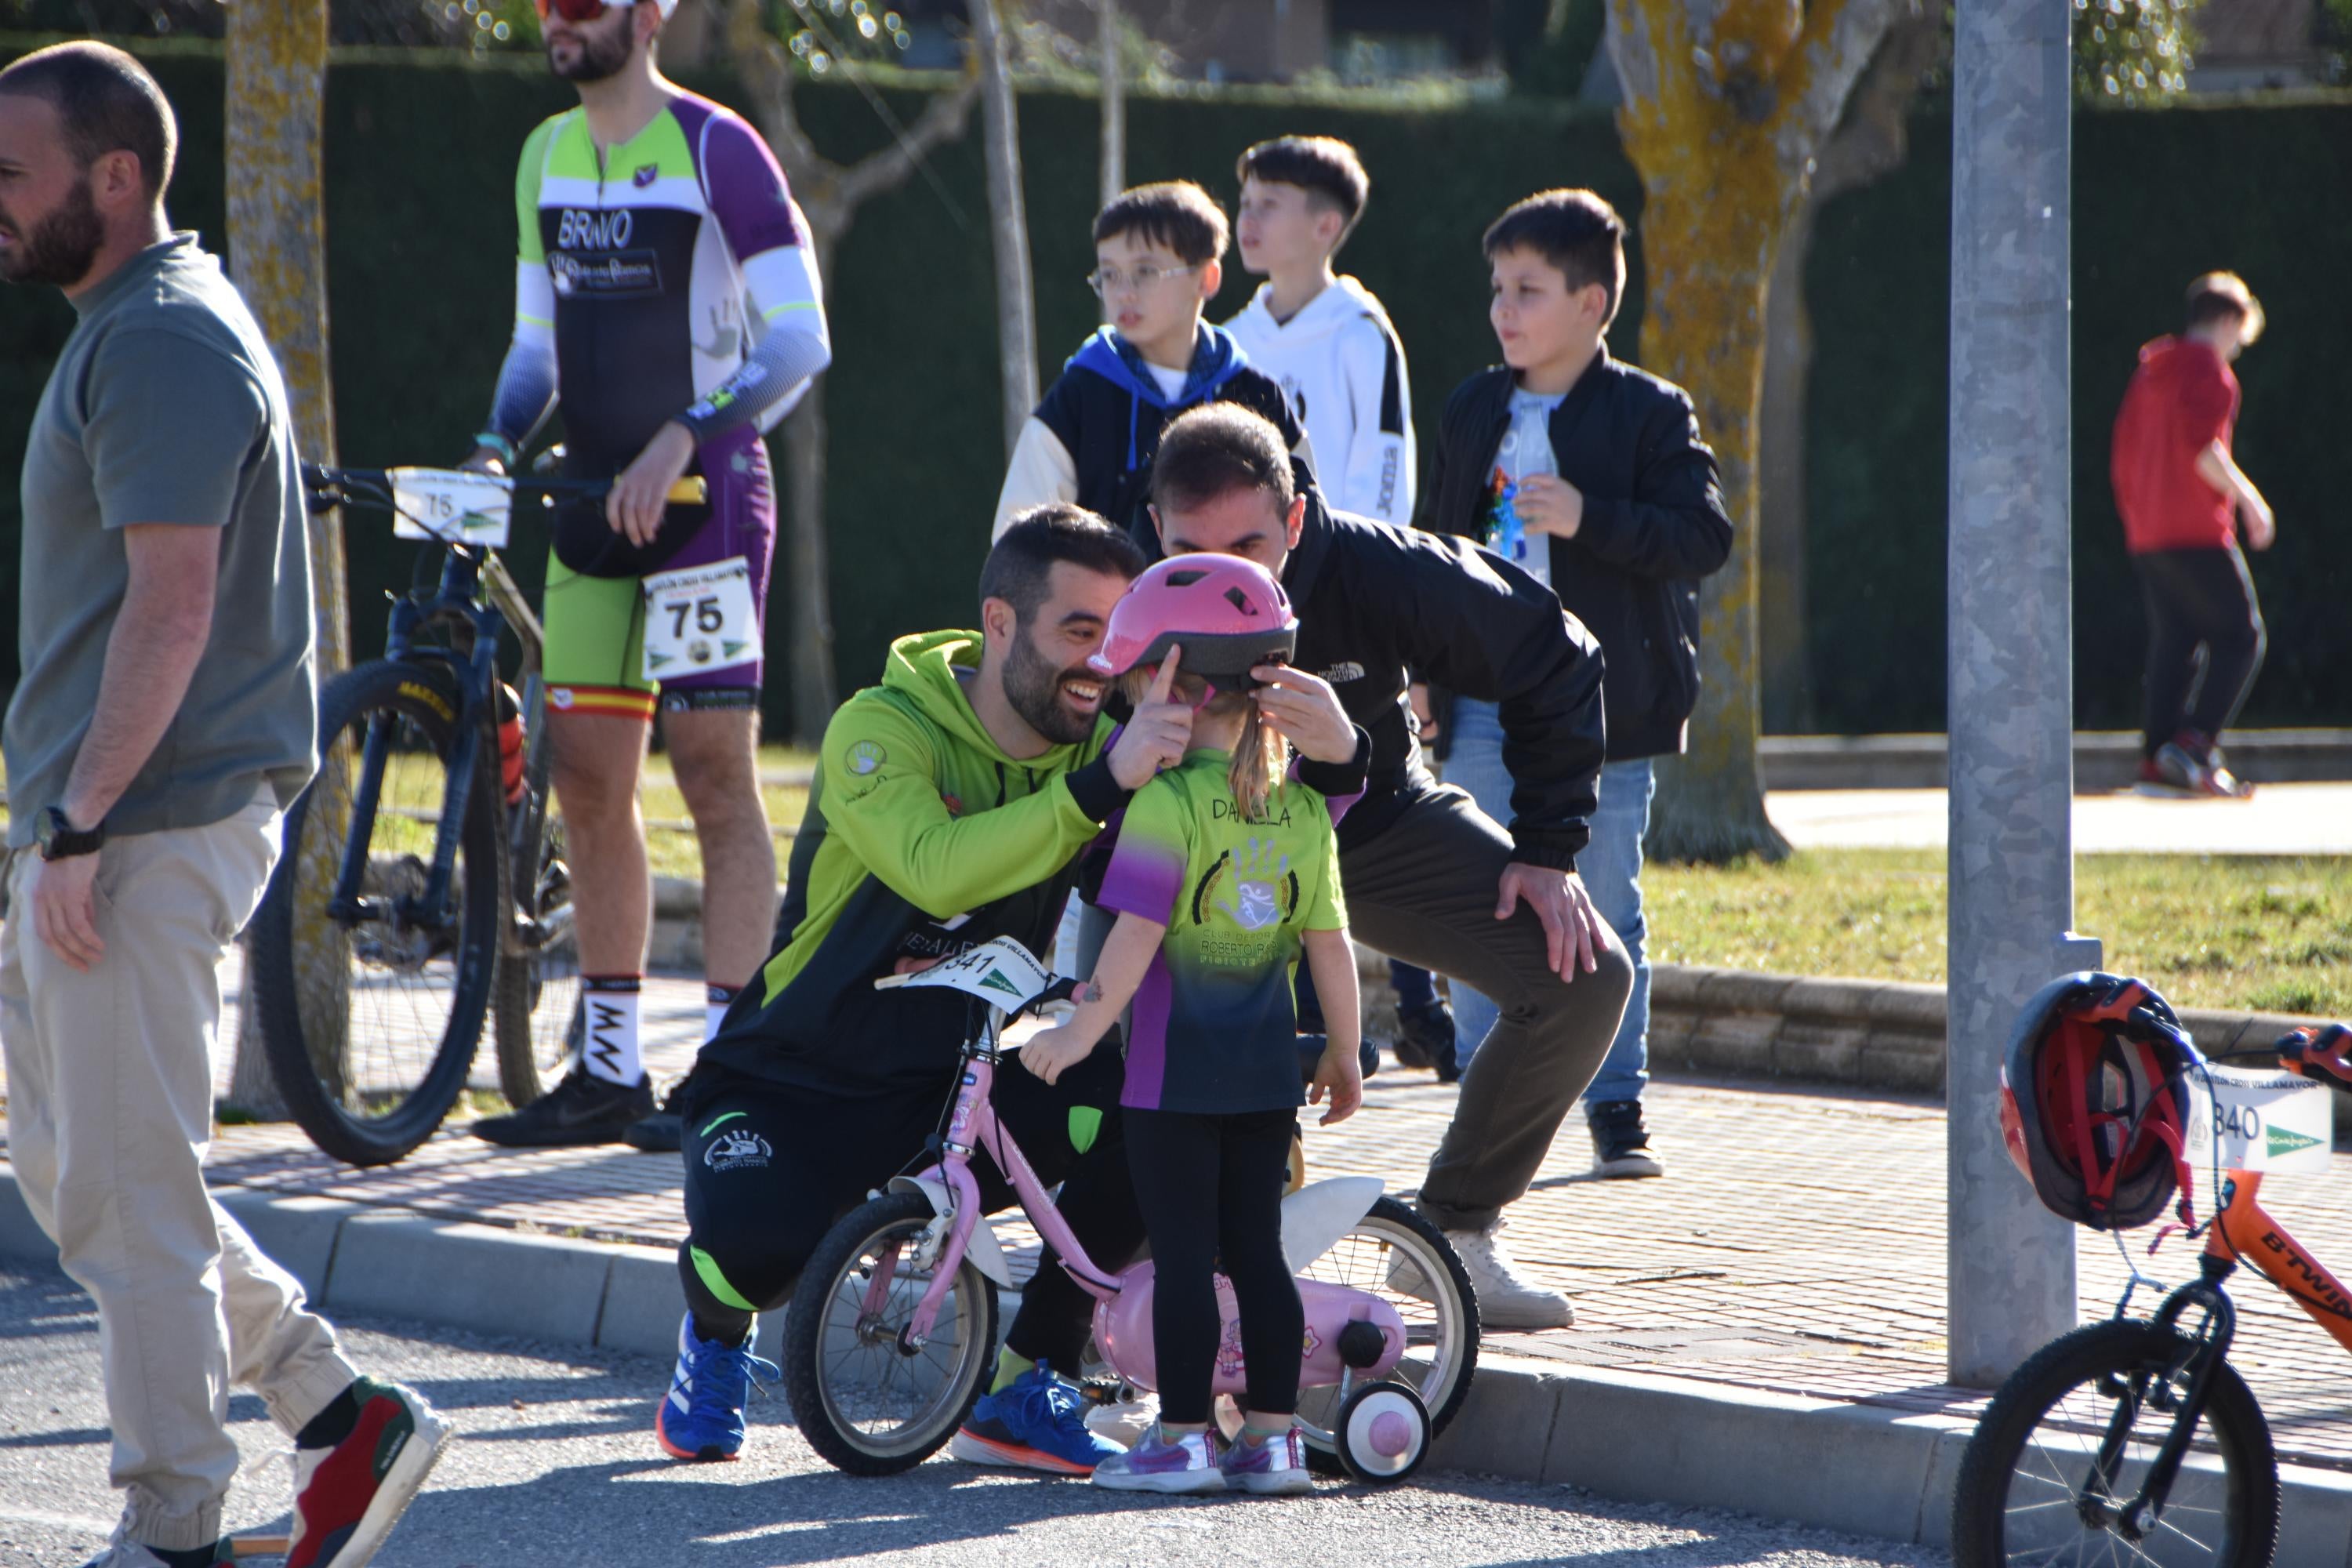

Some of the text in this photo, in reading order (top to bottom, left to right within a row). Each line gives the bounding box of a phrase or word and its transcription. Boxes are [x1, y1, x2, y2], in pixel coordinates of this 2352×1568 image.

[426, 493, 452, 517] 75
[665, 596, 723, 639] 75
[1330, 662, 1347, 672] THE
[1318, 670, 1348, 679] NORTH
[1203, 928, 1231, 939] CLUB
[1200, 940, 1252, 956] ROBERTO
[2230, 1078, 2250, 1088] CROSS
[2252, 1079, 2318, 1090] VILLAMAYOR
